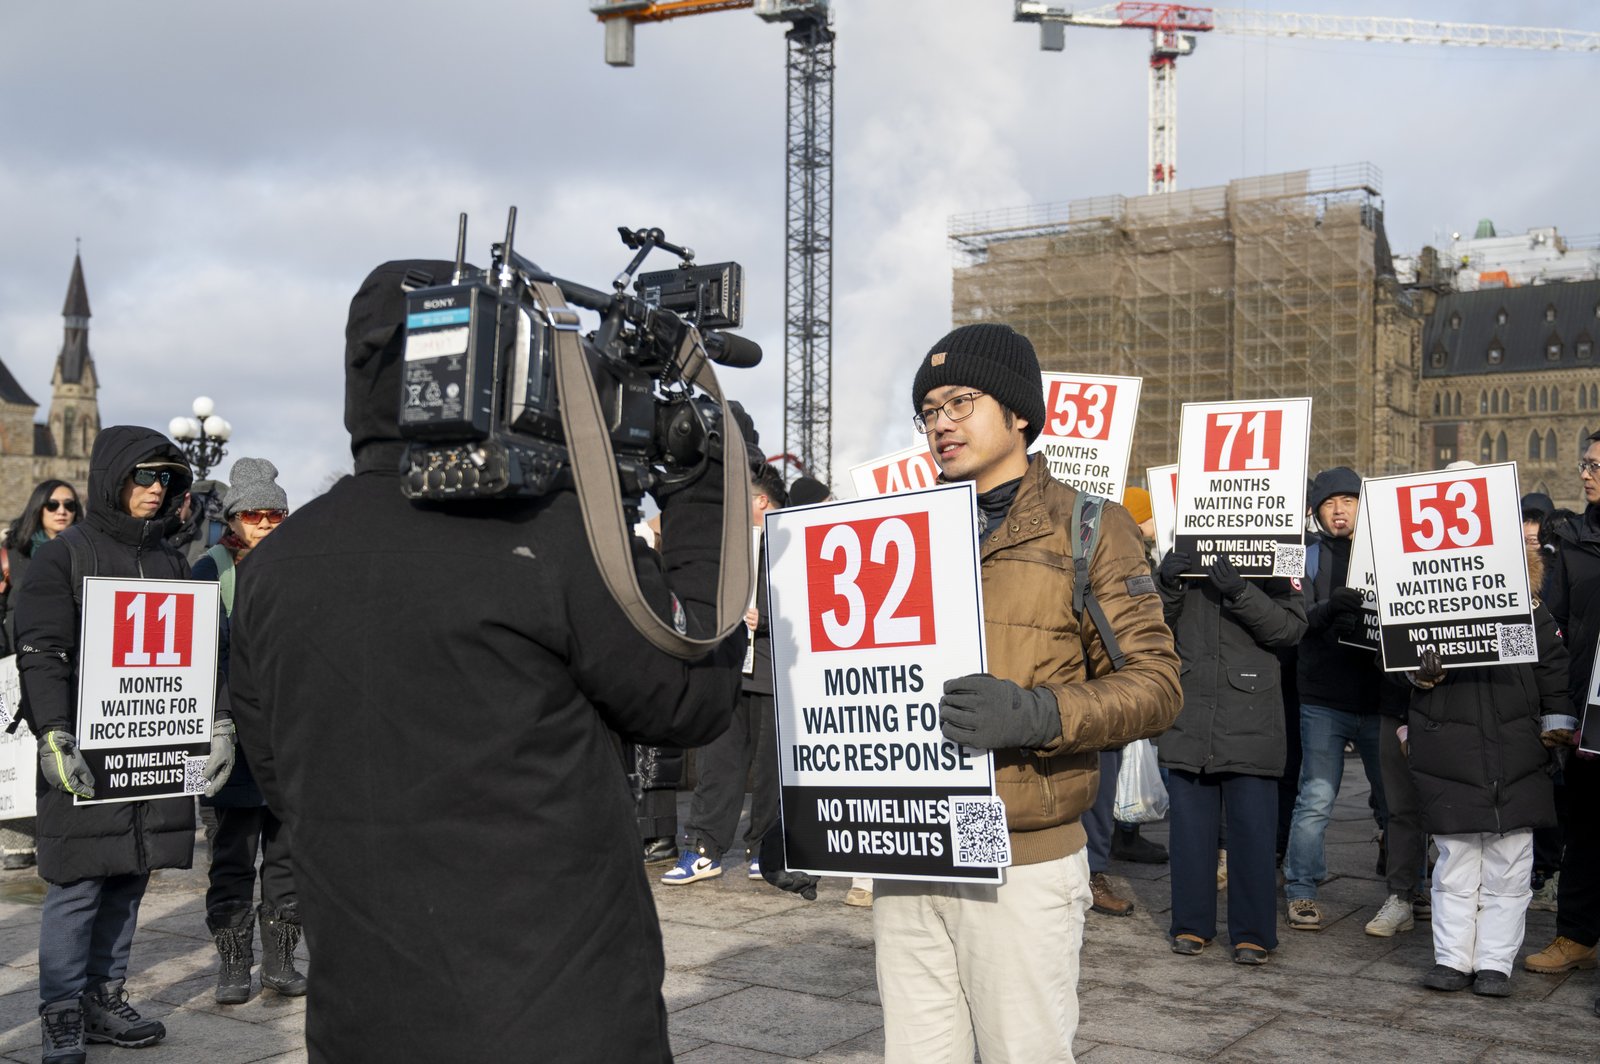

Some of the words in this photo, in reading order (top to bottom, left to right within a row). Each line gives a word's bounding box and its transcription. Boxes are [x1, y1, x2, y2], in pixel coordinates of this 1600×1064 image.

[423, 297, 455, 309] SONY
[1050, 382, 1108, 439] 53
[1216, 411, 1270, 470] 71
[1045, 444, 1098, 460] MONTHS
[1049, 461, 1081, 475] ITING
[1084, 464, 1110, 478] FOR
[1209, 478, 1270, 492] MONTHS
[1194, 496, 1253, 510] WAITING
[1257, 496, 1286, 509] FOR
[1184, 514, 1215, 528] IRCC
[1217, 513, 1294, 528] RESPONSE
[1410, 481, 1482, 550] 53
[1196, 540, 1214, 552] NO
[1215, 540, 1278, 552] TIMELINES
[1228, 554, 1272, 567] ESULTS
[1412, 555, 1485, 576] MONTHS
[819, 517, 921, 648] 32
[1396, 576, 1468, 597] WAITING
[1472, 573, 1507, 590] FOR
[1389, 600, 1426, 617] IRCC
[1428, 592, 1519, 614] RESPONSE
[124, 593, 181, 666] 11
[1364, 613, 1380, 627] NO
[1408, 628, 1428, 642] NO
[1439, 639, 1499, 656] RESULTS
[119, 676, 183, 694] MONTHS
[824, 663, 924, 696] MONTHS
[101, 698, 165, 717] WAITING
[170, 697, 197, 714] FOR
[803, 704, 899, 734] WAITING
[906, 702, 943, 731] FO
[90, 722, 125, 740] IRCC
[128, 718, 204, 738] RESPONSE
[105, 754, 124, 770] NO
[126, 750, 189, 768] TIMELINES
[793, 743, 841, 772] IRCC
[844, 741, 974, 772] RESPONSE
[110, 772, 128, 788] NO
[131, 768, 184, 786] RESULTS
[817, 798, 843, 822] NO
[846, 798, 950, 824] TIMELINES
[827, 829, 853, 852] NO
[858, 830, 944, 857] RESULTS
